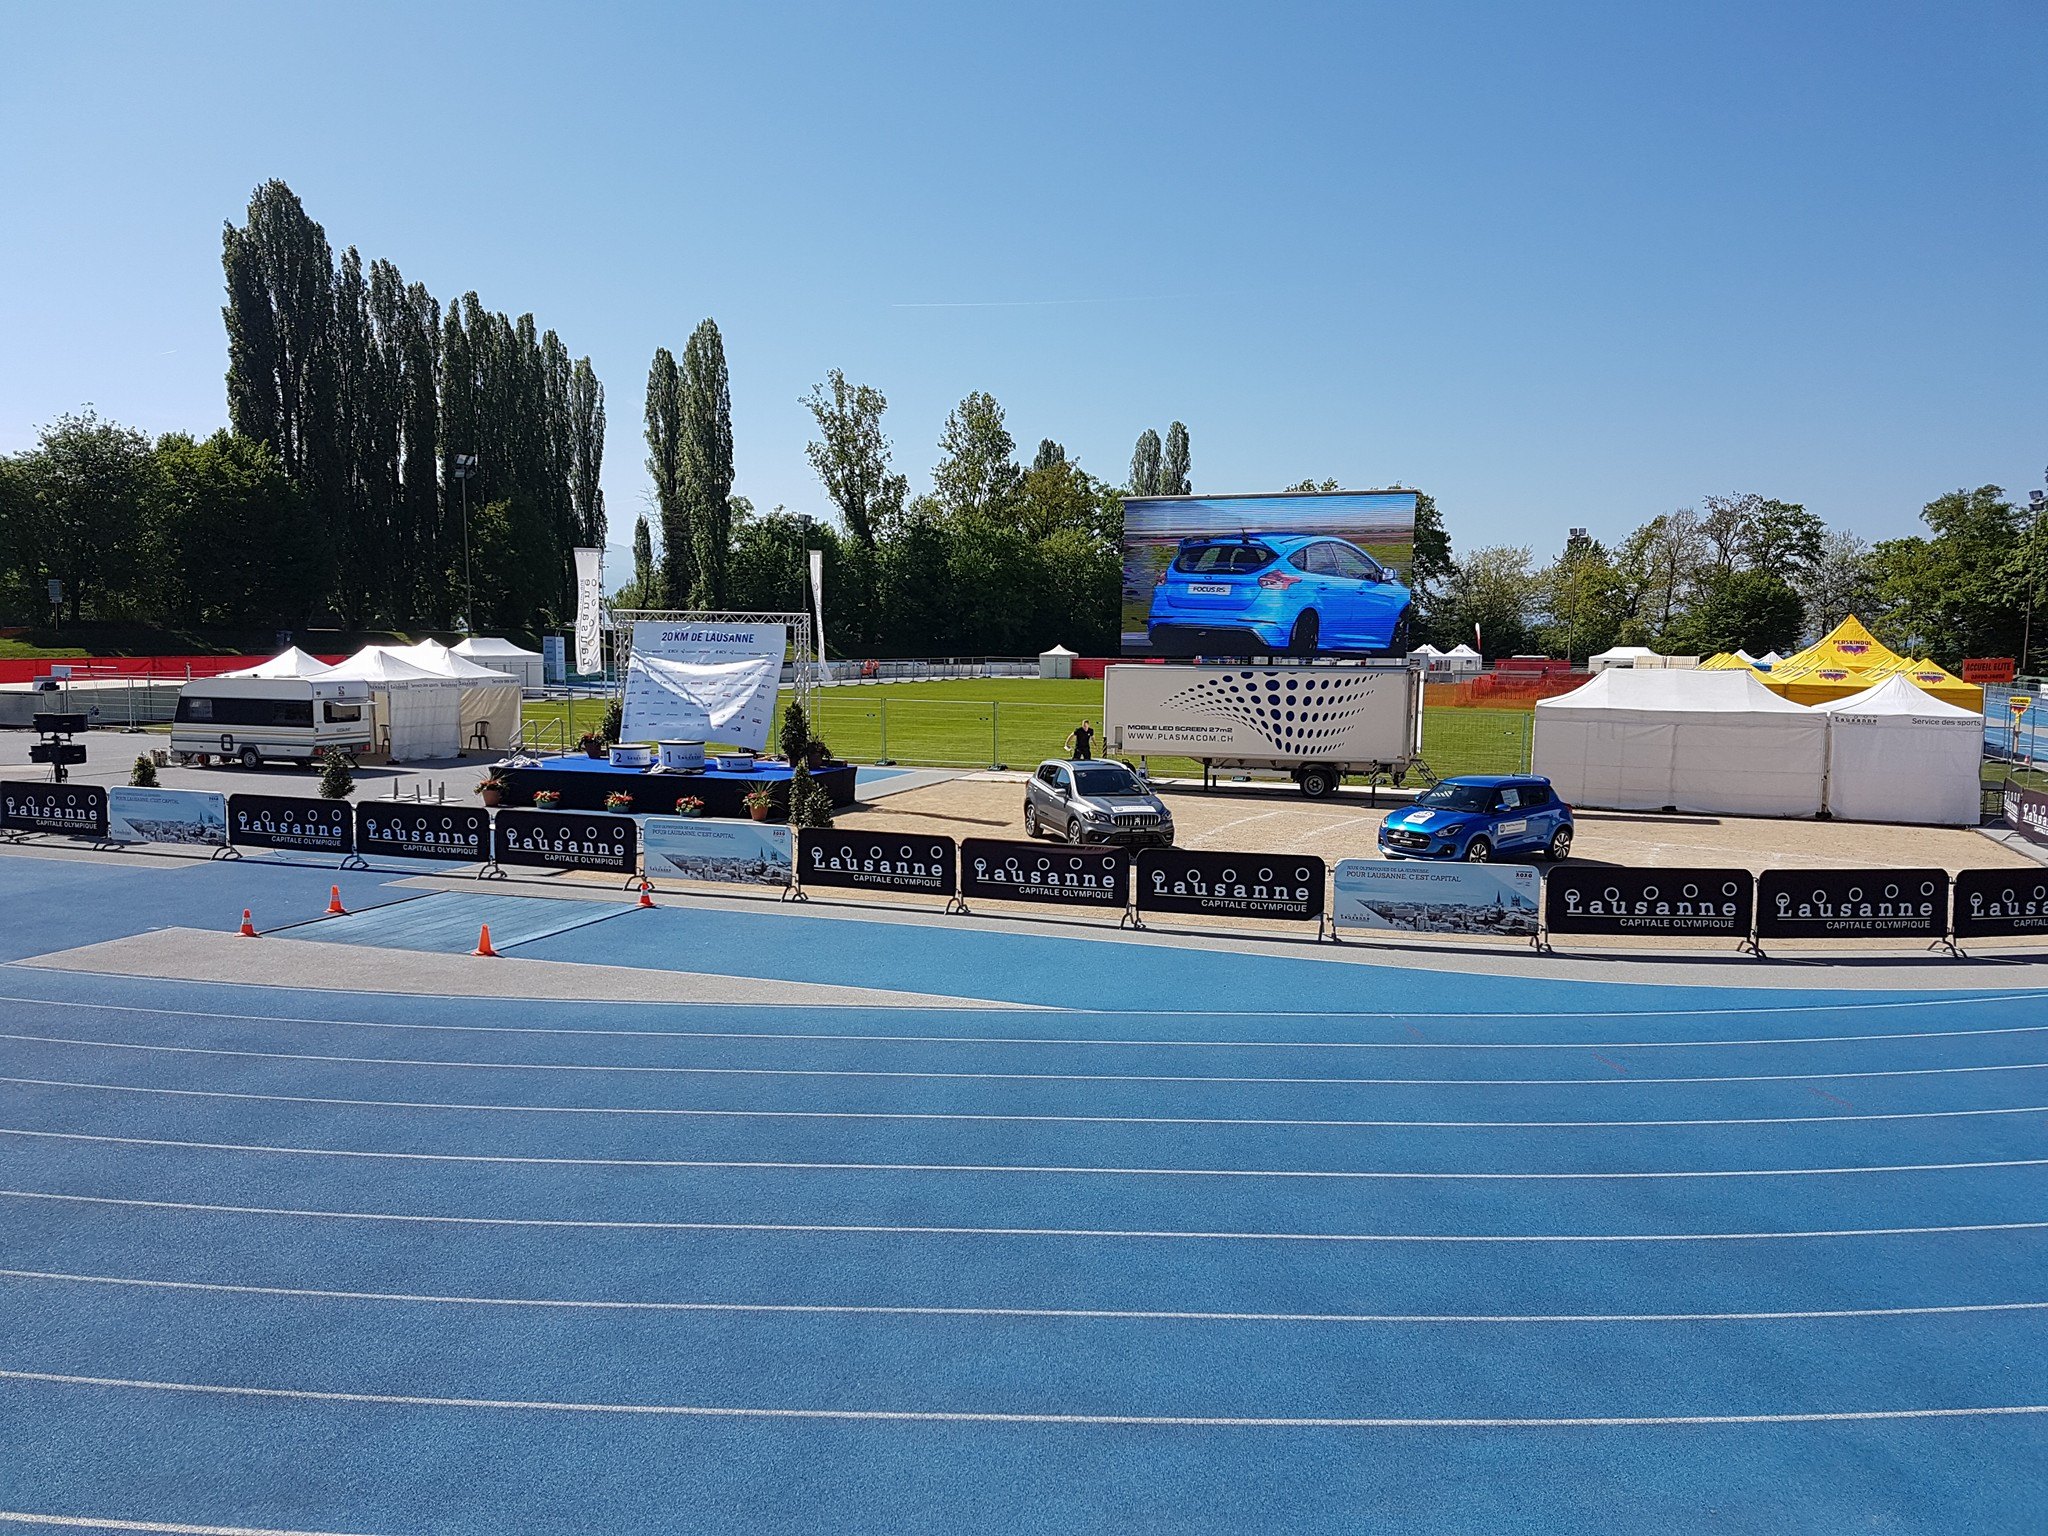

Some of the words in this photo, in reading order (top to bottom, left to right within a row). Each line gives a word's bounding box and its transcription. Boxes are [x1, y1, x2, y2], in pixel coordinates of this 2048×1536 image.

[691, 632, 703, 642] DE
[705, 632, 755, 643] LAUSANNE
[1965, 662, 1992, 671] ACCUEIL
[1912, 717, 1940, 725] Service
[1941, 718, 1955, 726] des
[1956, 718, 1981, 727] sports
[1127, 732, 1234, 743] WWW.PLASMACOM.CH
[615, 752, 622, 763] 2
[666, 751, 672, 762] 1
[8, 801, 98, 820] Lausanne
[36, 819, 63, 827] CAPITALE
[64, 821, 98, 830] OLYMPIQUE
[239, 815, 342, 837] Lausanne
[368, 823, 479, 845] Lausanne
[271, 835, 303, 844] CAPITALE
[304, 837, 342, 847] OLYMPIQUE
[508, 832, 625, 856] Lausanne
[402, 844, 436, 853] CAPITALE
[437, 845, 478, 855] OLYMPIQUE
[544, 854, 579, 863] CAPITALE
[580, 856, 624, 866] OLYMPIQUE
[813, 851, 943, 877] Lausanne
[977, 862, 1115, 888] Lausanne
[1346, 870, 1366, 878] POUR
[853, 873, 892, 884] CAPITALE
[893, 876, 942, 888] OLYMPIQUE
[1019, 885, 1060, 897] CAPITALE
[1062, 887, 1114, 899] OLYMPIQUE
[1154, 874, 1309, 901] Lausanne
[1200, 898, 1248, 909] CAPITALE
[1249, 901, 1307, 913] OLYMPIQUE
[1566, 894, 1737, 916] Lausanne
[1777, 899, 1933, 917] Lausanne
[1620, 918, 1670, 928] CAPITALE
[1673, 919, 1735, 929] OLYMPIQUE
[1826, 921, 1873, 930] CAPITALE
[1875, 920, 1931, 930] OLYMPIQUE
